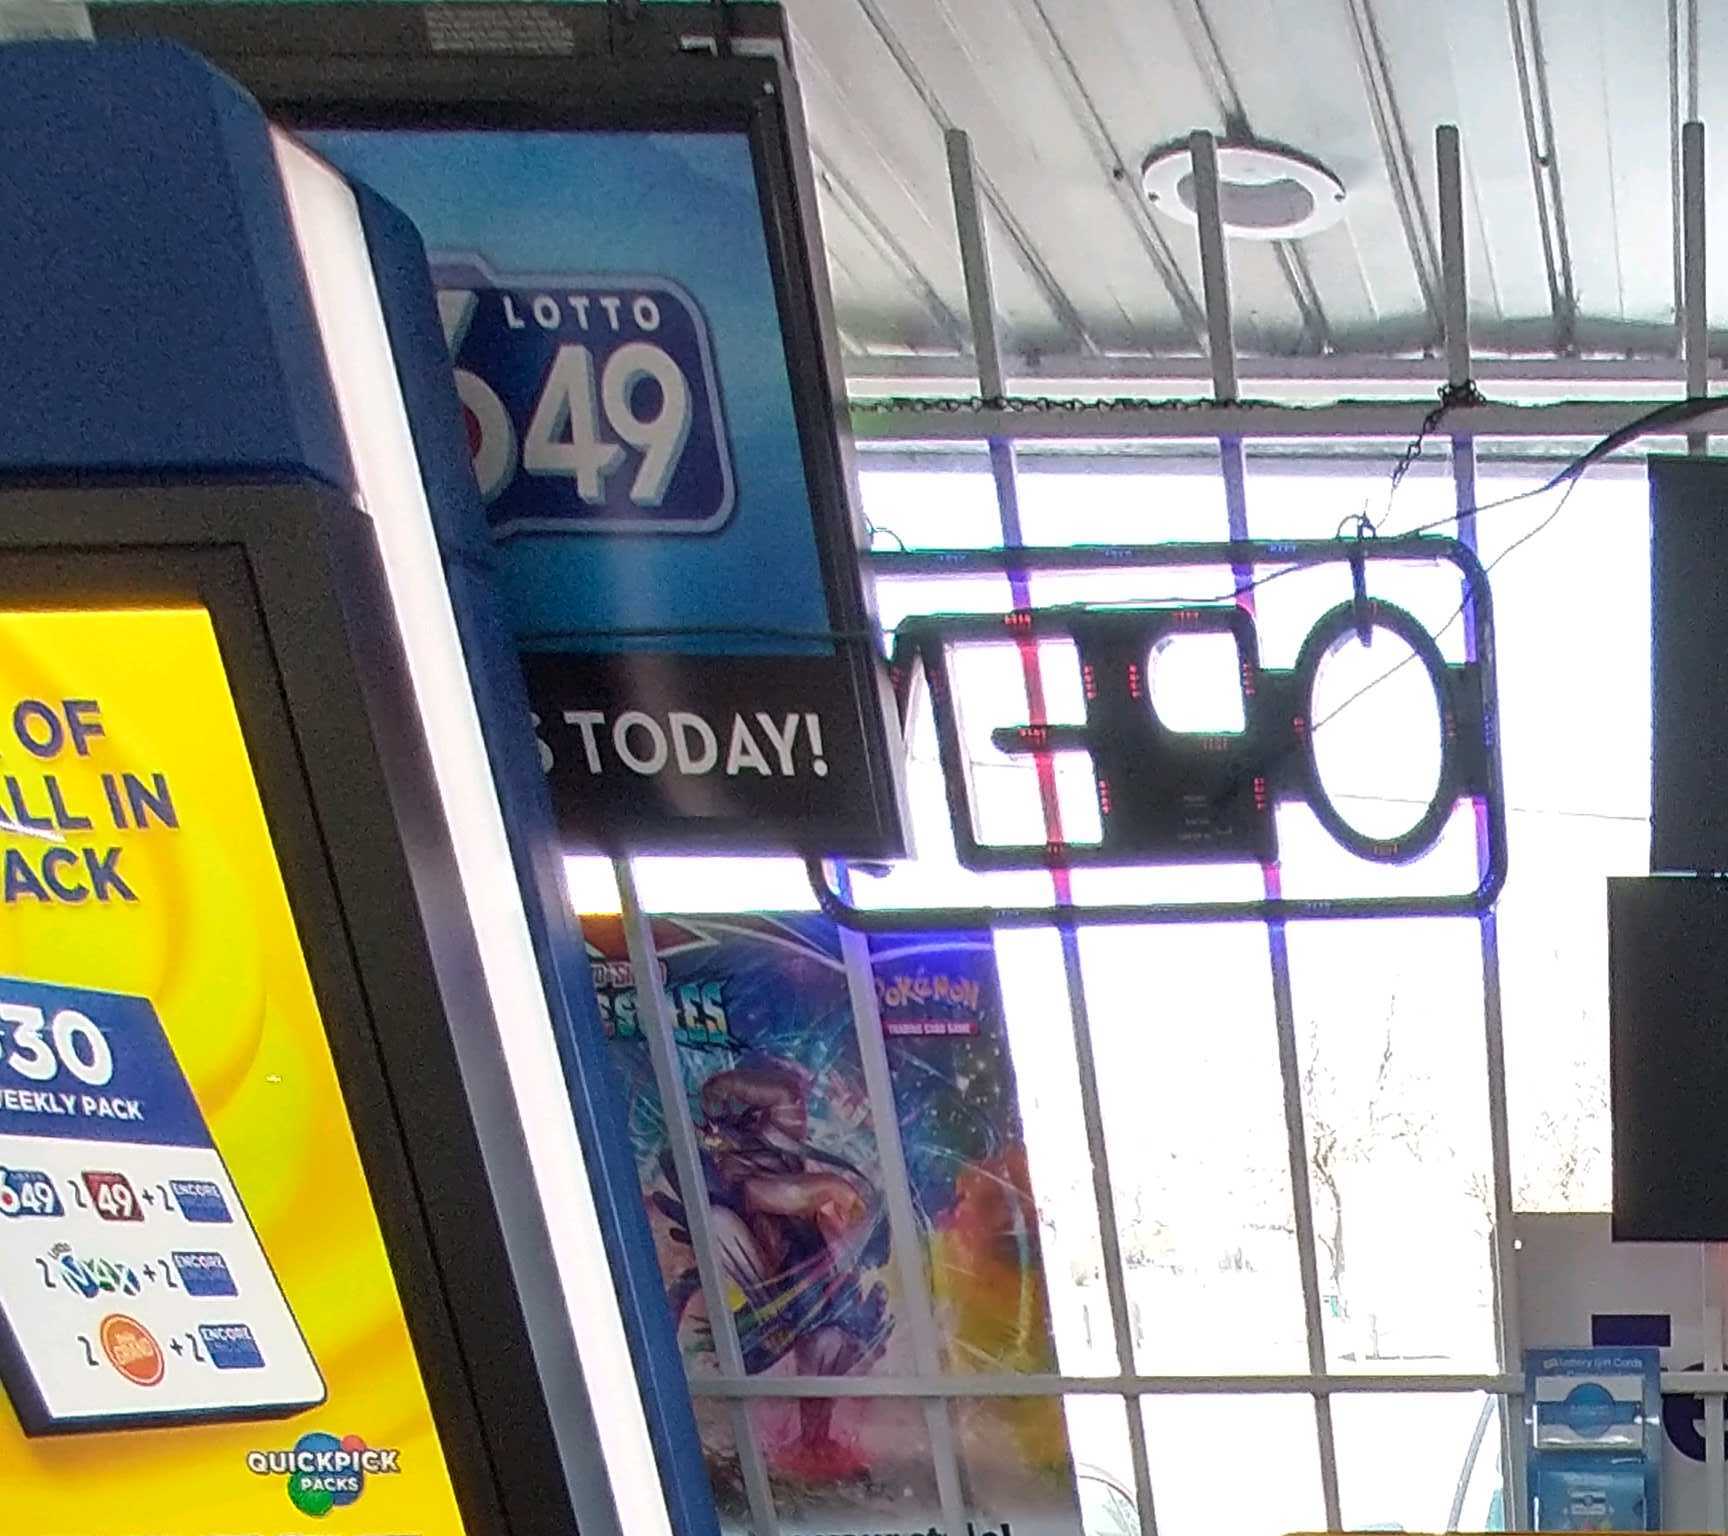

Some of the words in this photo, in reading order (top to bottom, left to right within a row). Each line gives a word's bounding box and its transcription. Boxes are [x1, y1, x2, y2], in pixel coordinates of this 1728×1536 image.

[504, 293, 662, 331] LOTTO
[14, 699, 106, 758] OF
[563, 711, 829, 777] TODAY!
[101, 771, 180, 830] IN
[3, 847, 140, 903] ACK
[0, 1003, 114, 1087] 30
[0, 1088, 77, 1114] EEKLY
[82, 1095, 144, 1121] PACK
[246, 1448, 400, 1475] QUICKPICK
[300, 1475, 360, 1493] PACKS
